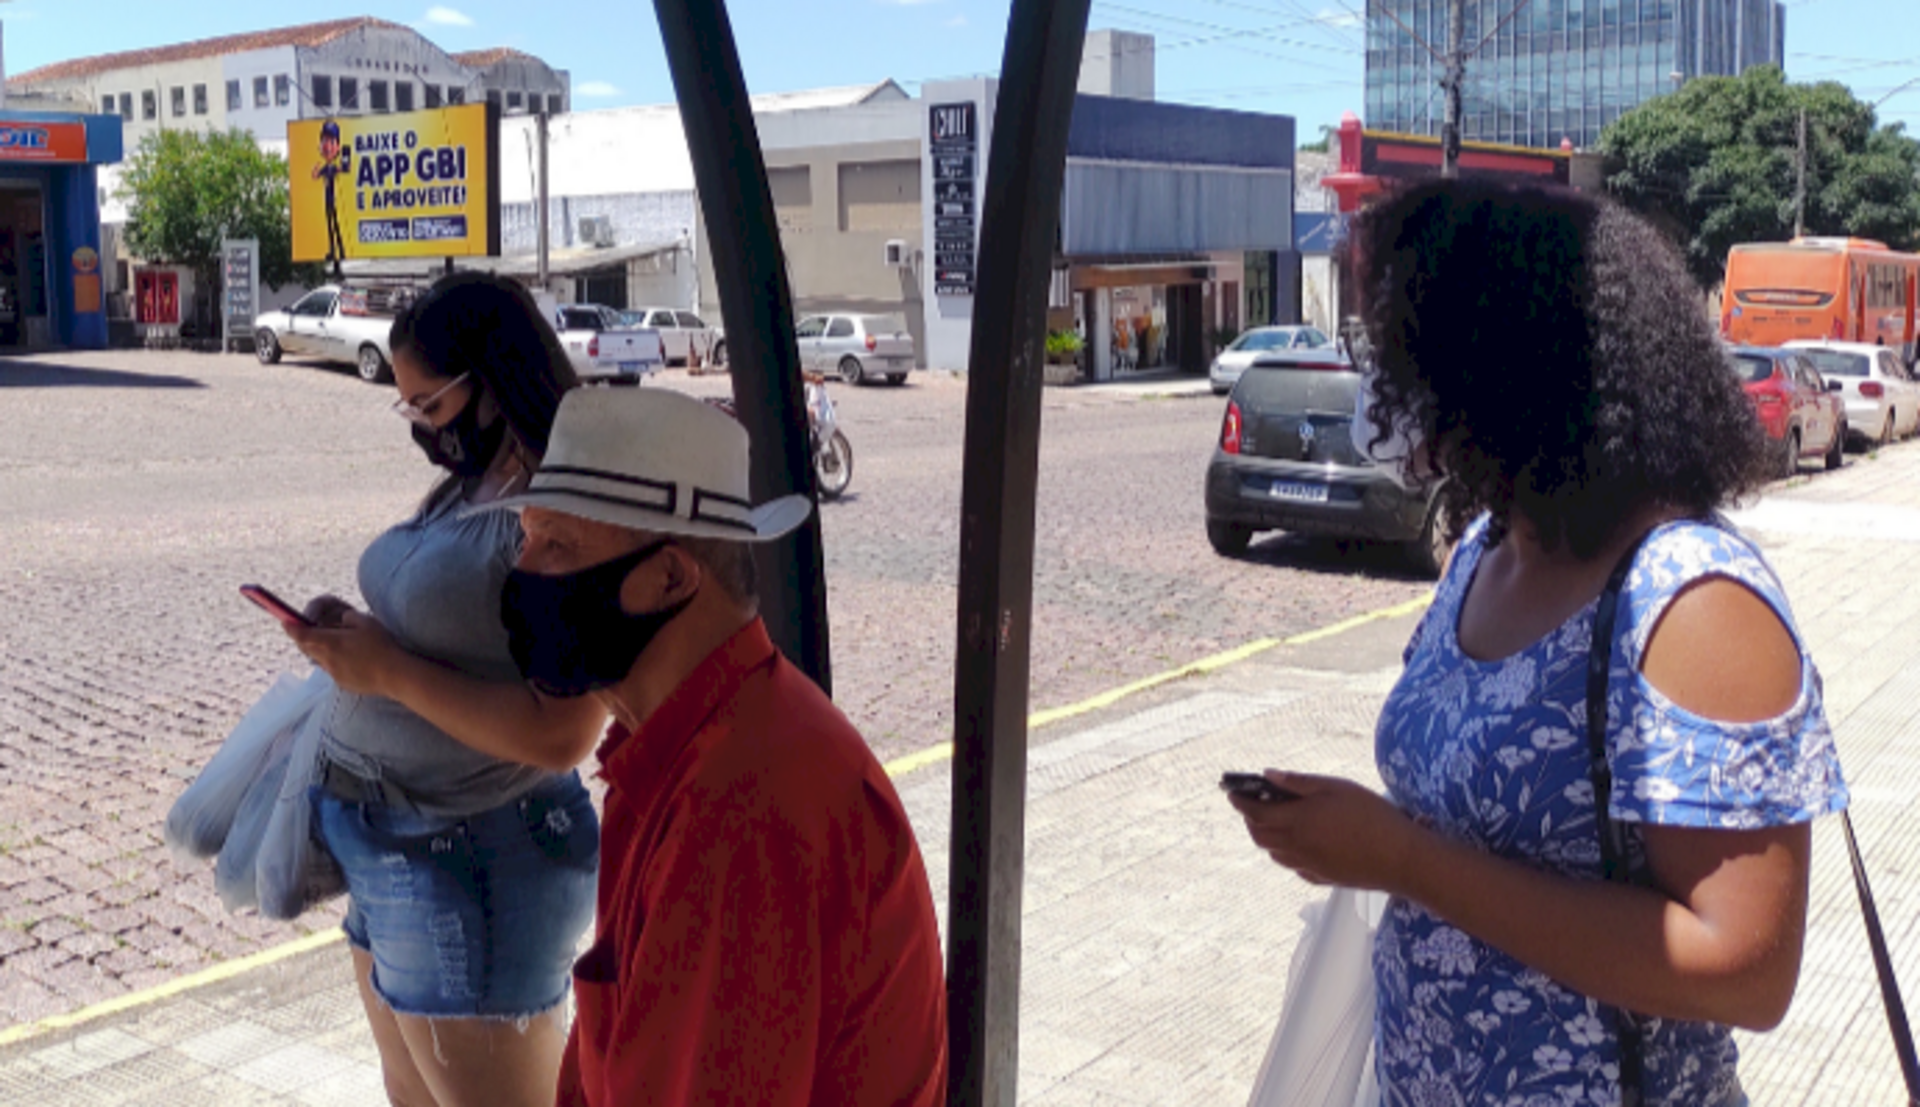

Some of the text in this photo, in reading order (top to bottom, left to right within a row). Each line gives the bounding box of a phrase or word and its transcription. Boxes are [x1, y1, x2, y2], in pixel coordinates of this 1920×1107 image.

[355, 130, 417, 153] BAIXE O
[356, 145, 466, 187] APP GBI
[356, 185, 466, 210] E APROVEITE!
